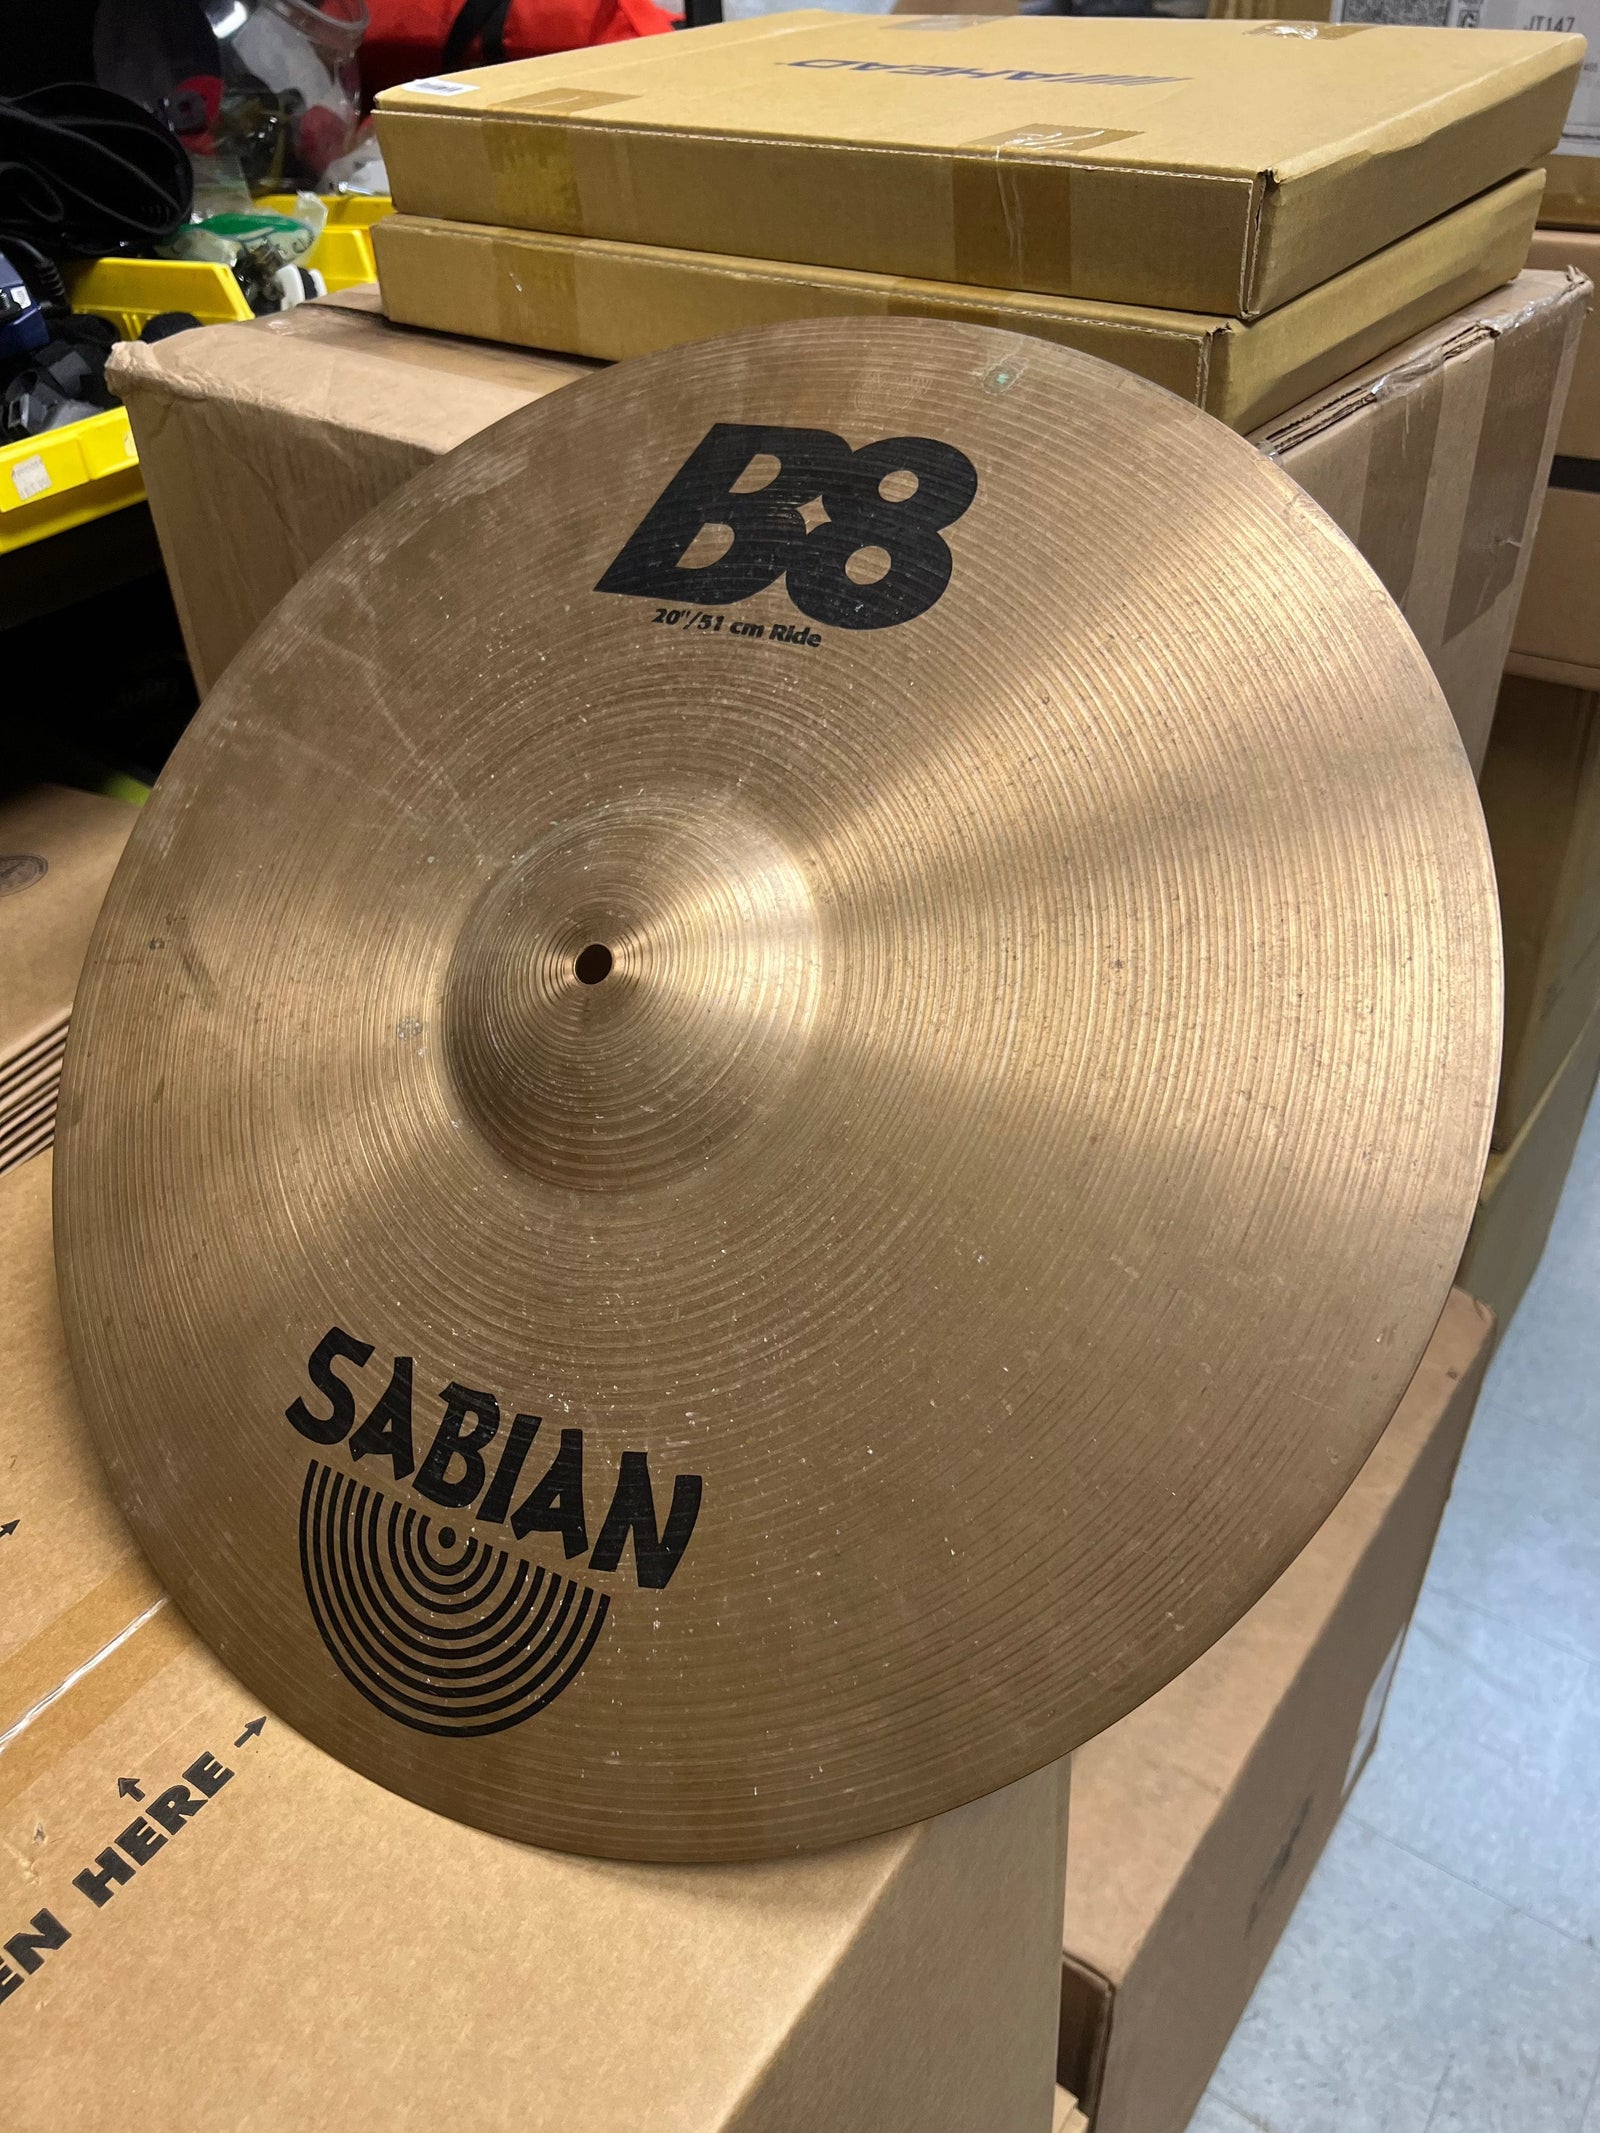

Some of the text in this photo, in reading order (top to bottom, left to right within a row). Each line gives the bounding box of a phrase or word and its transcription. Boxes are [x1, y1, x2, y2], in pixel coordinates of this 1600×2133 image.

[774, 58, 1070, 82] AHEAD
[593, 423, 978, 631] B8
[651, 608, 822, 648] 20"/51 cm Ride
[285, 1326, 703, 1590] SABIAN
[72, 1750, 235, 1908] HERE
